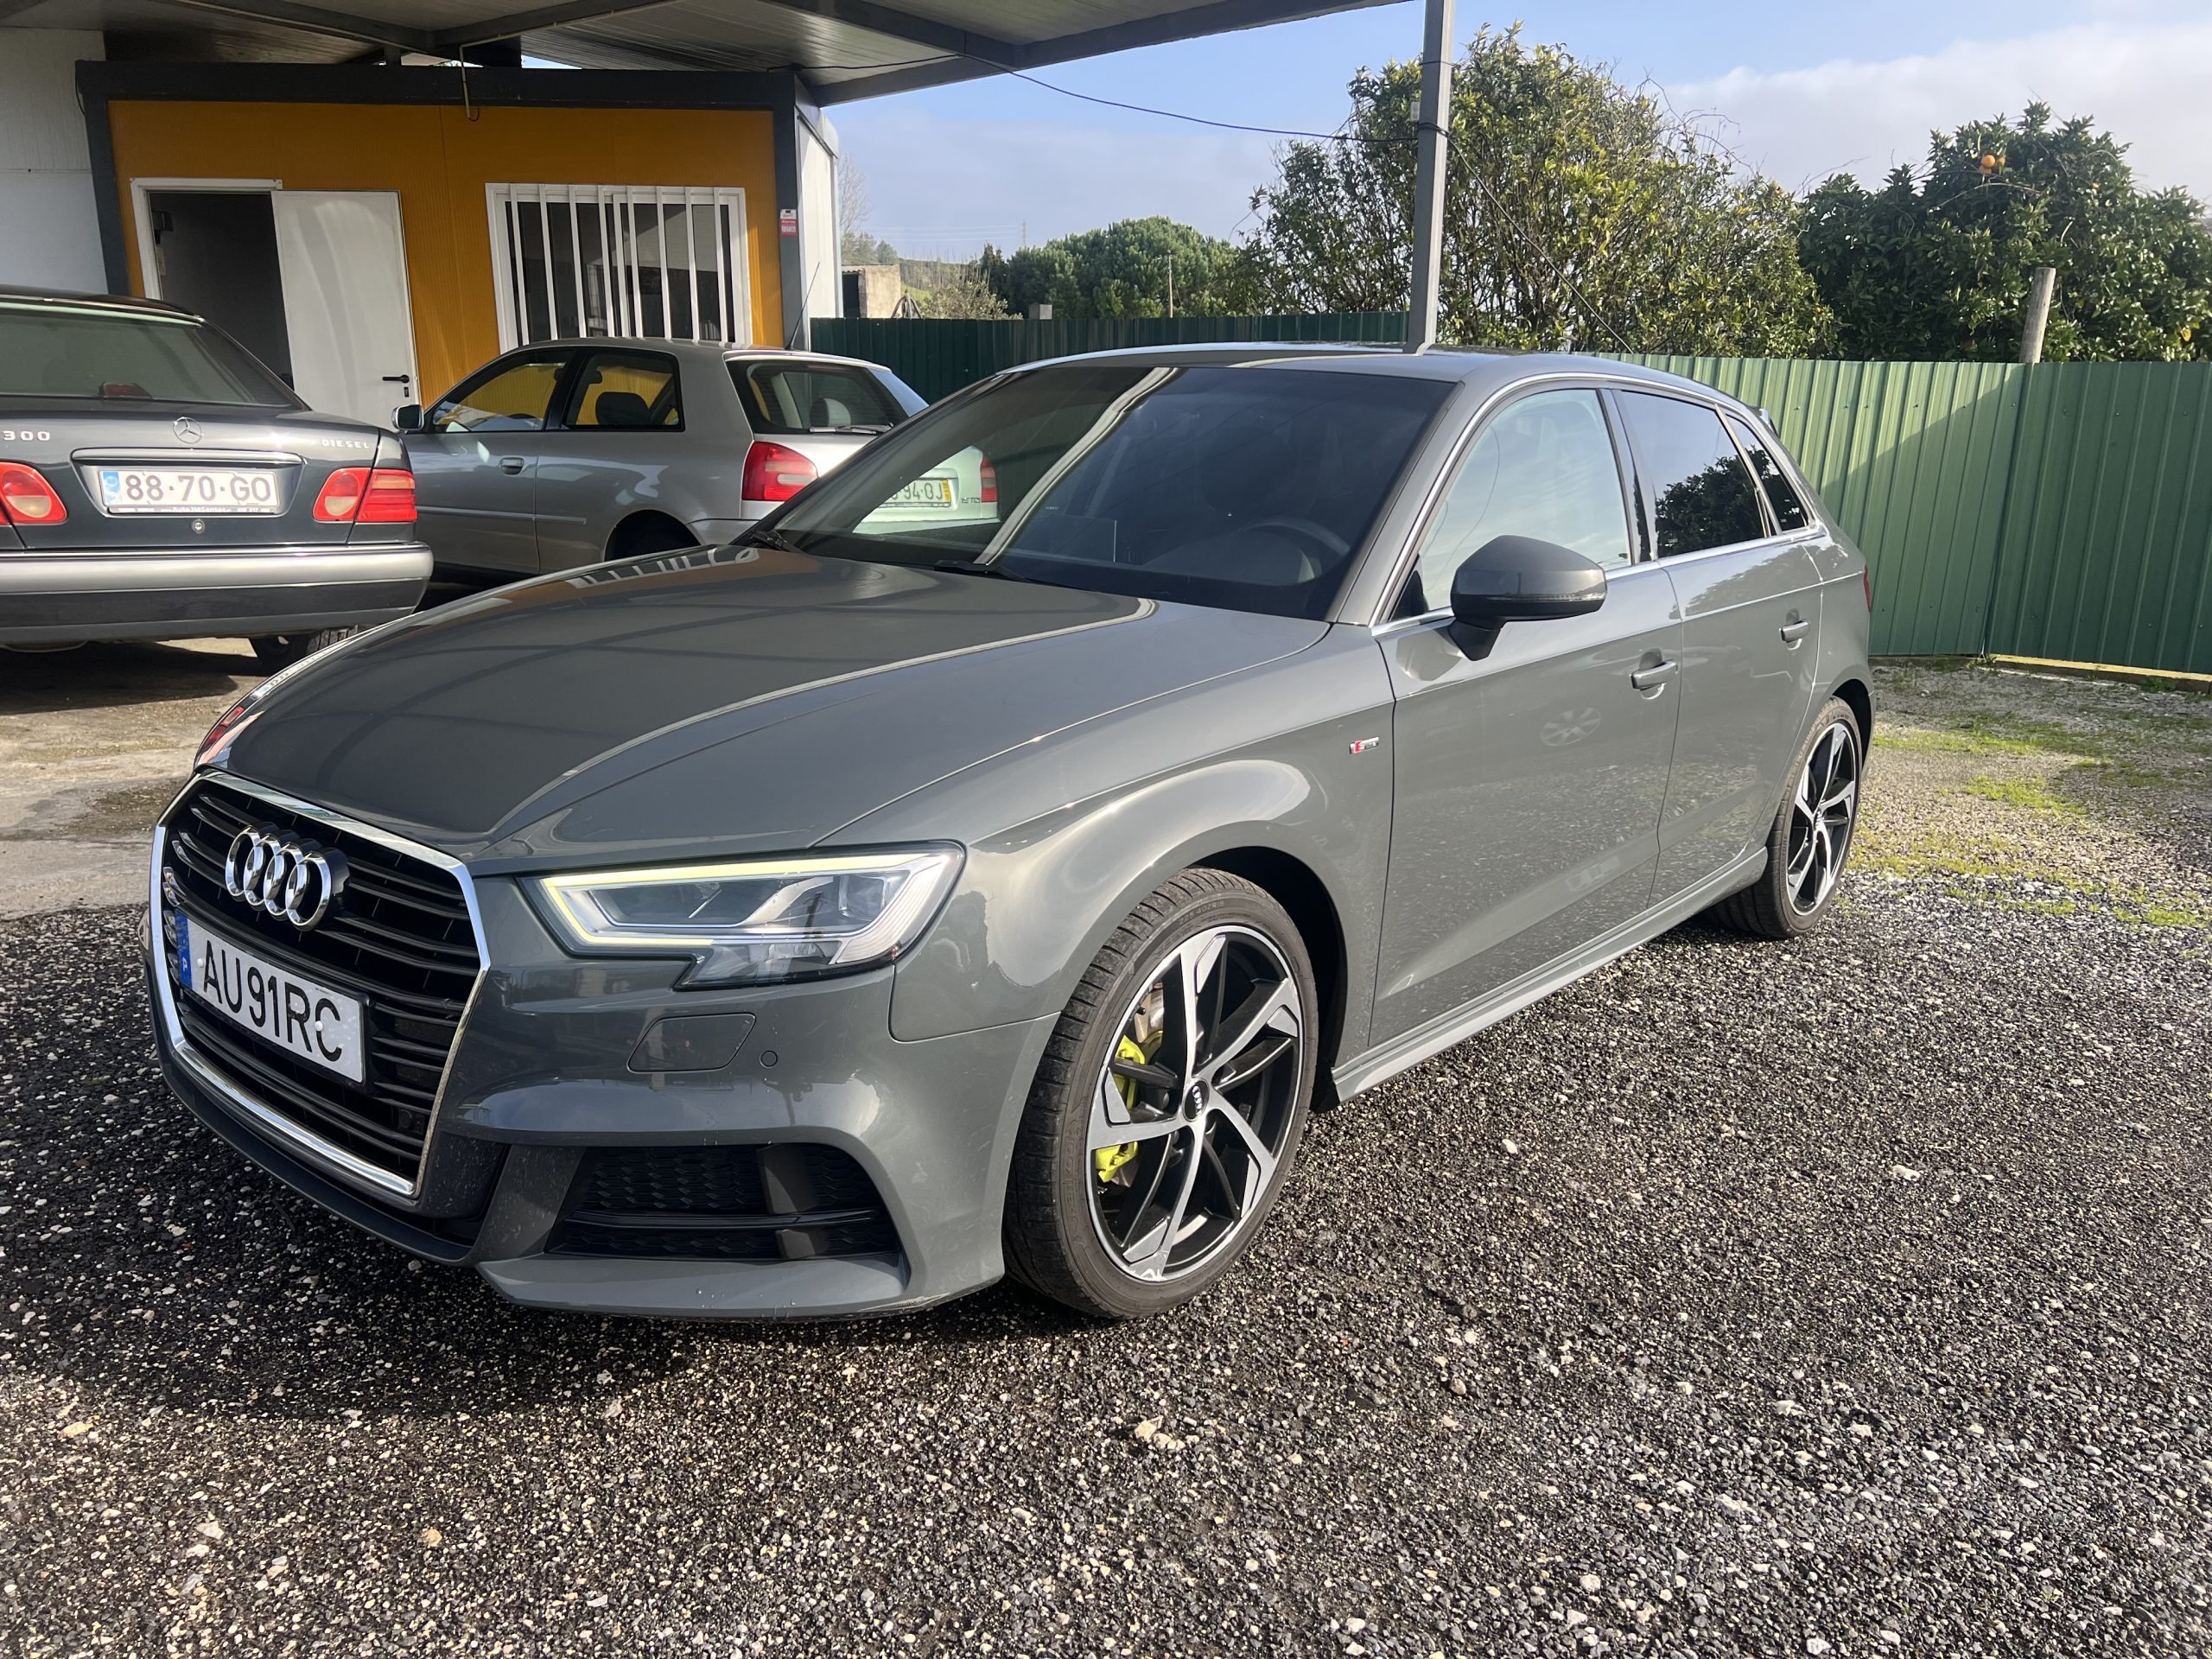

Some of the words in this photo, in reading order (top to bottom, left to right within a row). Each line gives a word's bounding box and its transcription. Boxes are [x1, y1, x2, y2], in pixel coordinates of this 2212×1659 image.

[3, 430, 50, 442] 300
[321, 439, 370, 449] DIESEL
[202, 938, 343, 1063] AU91RC
